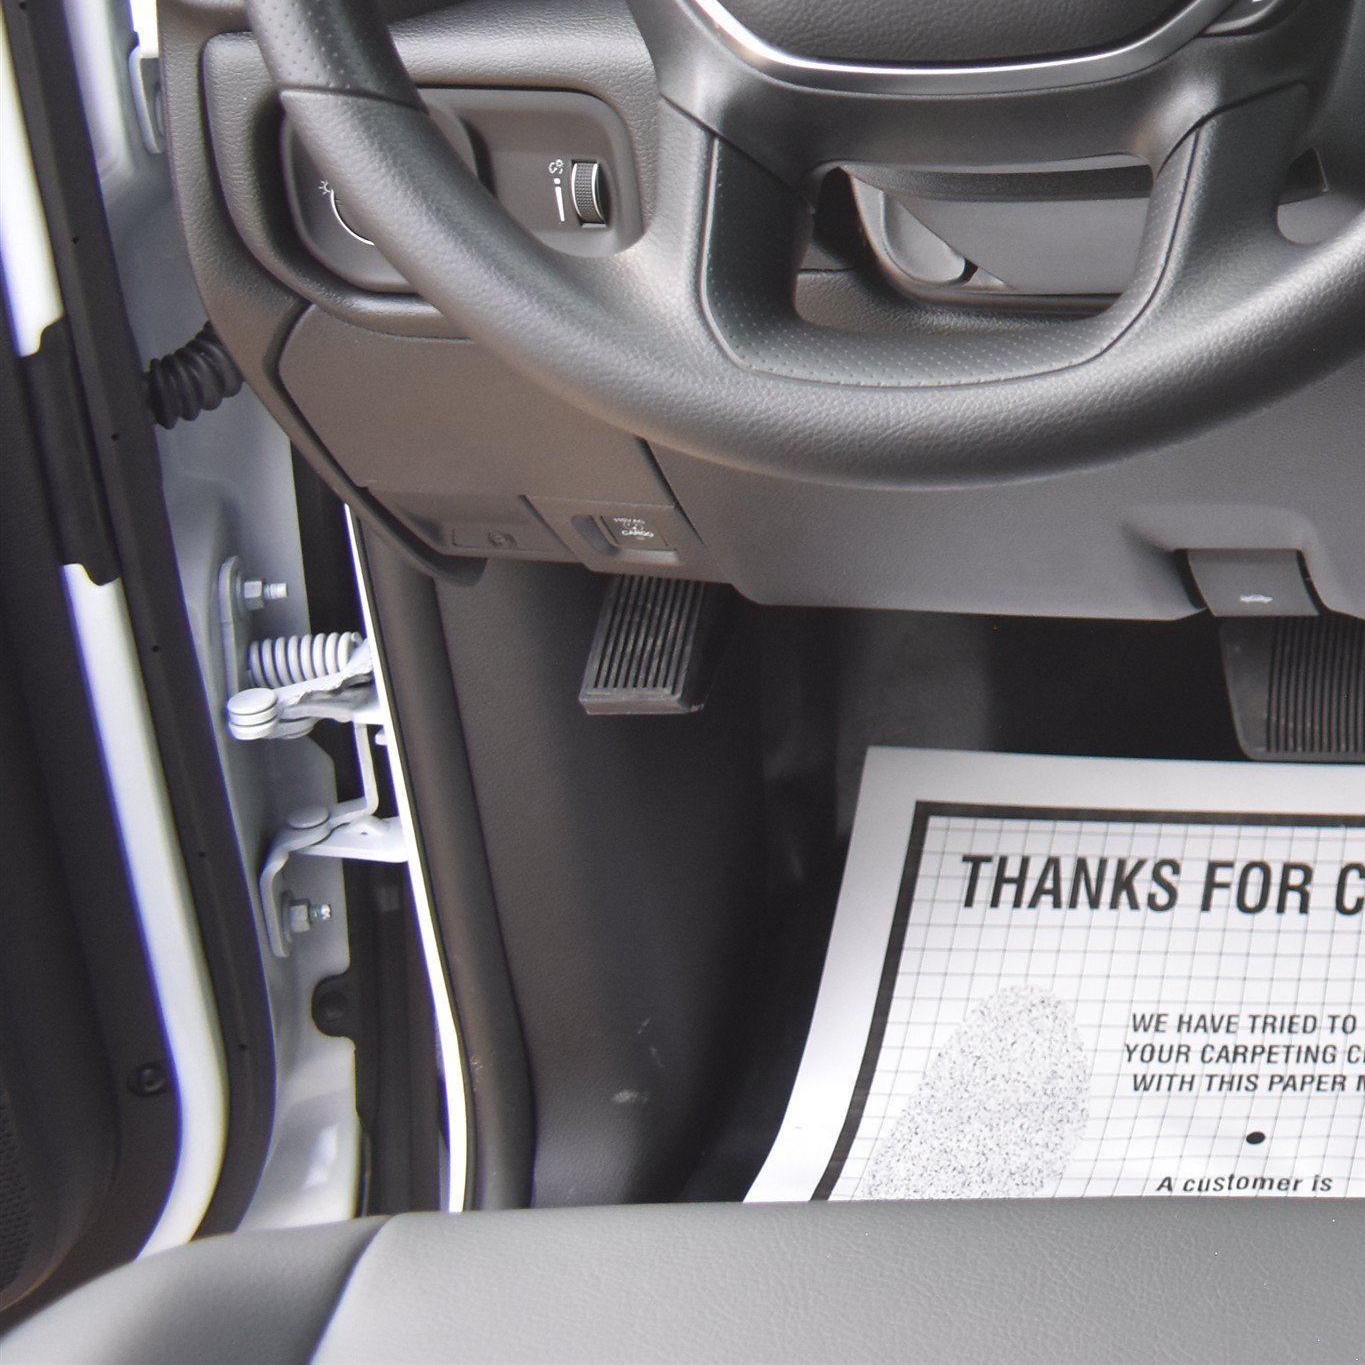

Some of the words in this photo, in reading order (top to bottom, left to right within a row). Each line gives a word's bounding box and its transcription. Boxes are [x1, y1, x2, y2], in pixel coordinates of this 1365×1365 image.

[961, 853, 1182, 912] THANKS
[1202, 859, 1314, 914] FOR
[1131, 1013, 1169, 1033] WE
[1177, 1014, 1240, 1034] HAVE
[1248, 1014, 1318, 1034] TRIED
[1328, 1014, 1357, 1034] TO
[1124, 1044, 1191, 1064] YOUR
[1201, 1044, 1337, 1064] CARPETING
[1132, 1073, 1196, 1092] WITH
[1205, 1073, 1260, 1092] THIS
[1268, 1074, 1347, 1092] PAPER
[1155, 1176, 1173, 1192] A
[1183, 1173, 1302, 1193] customer
[1312, 1173, 1333, 1193] is
